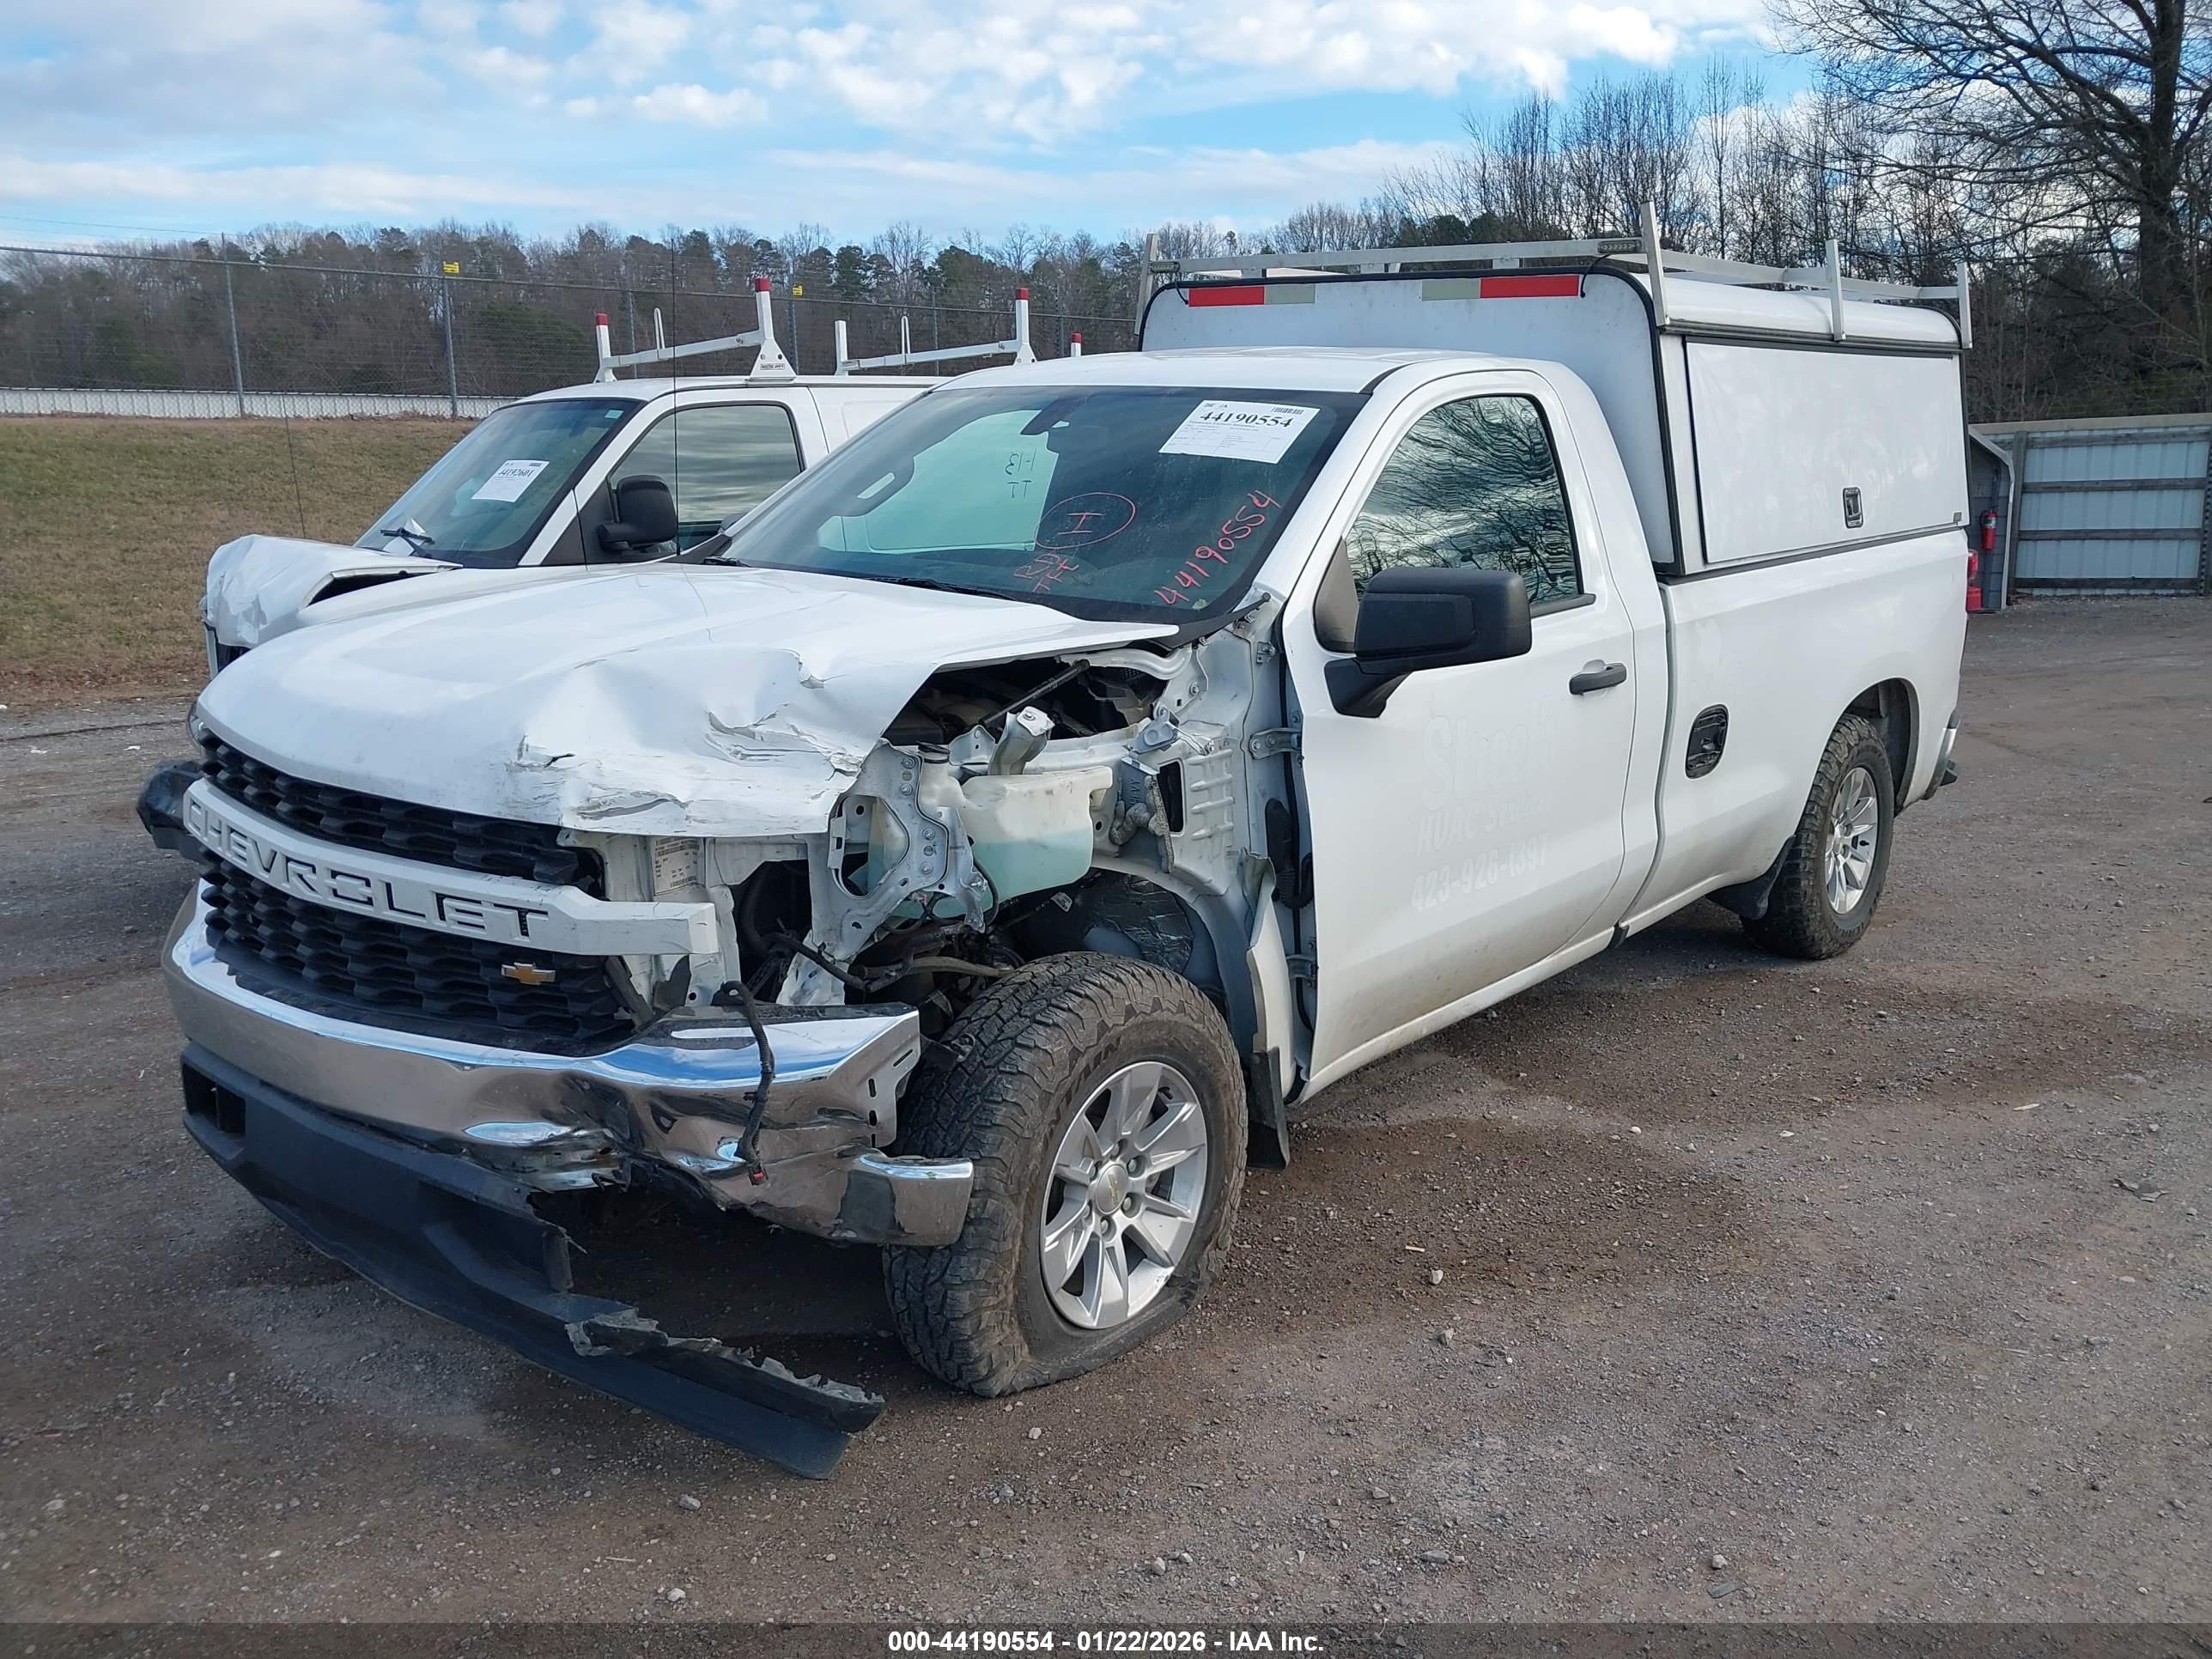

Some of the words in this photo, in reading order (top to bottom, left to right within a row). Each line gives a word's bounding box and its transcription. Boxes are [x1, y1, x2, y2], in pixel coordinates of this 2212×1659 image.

[1200, 411, 1294, 428] 44190554
[1154, 489, 1281, 604] 44190554
[187, 796, 550, 943] CHEVROLET
